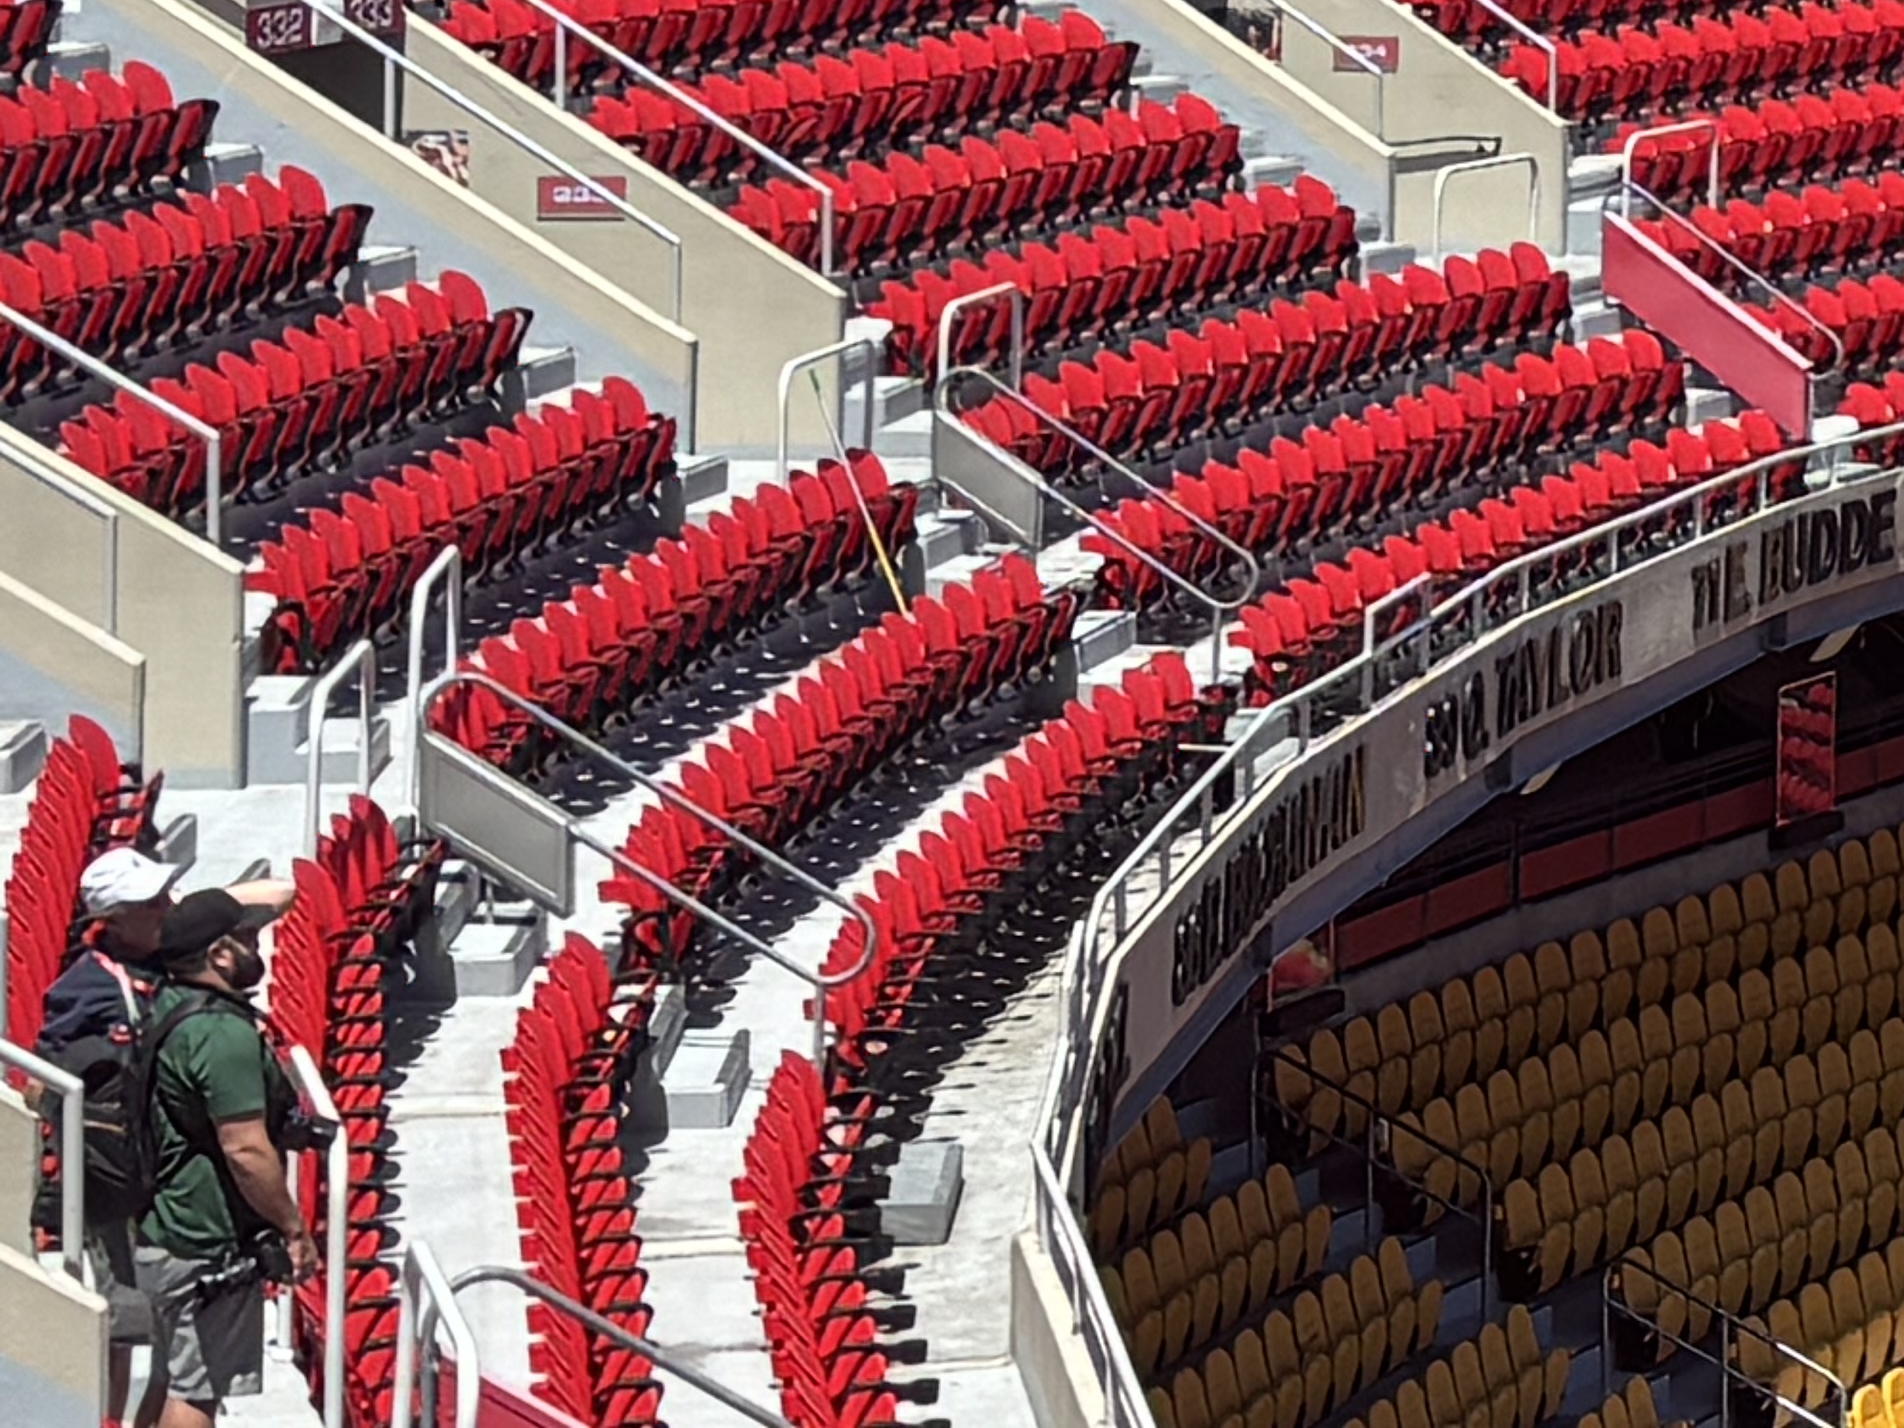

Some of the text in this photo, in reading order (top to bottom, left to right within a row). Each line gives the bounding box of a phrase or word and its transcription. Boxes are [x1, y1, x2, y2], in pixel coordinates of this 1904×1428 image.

[257, 7, 304, 49] 332
[1757, 488, 1897, 607] BUDDE
[1495, 599, 1623, 740] TAYLOR
